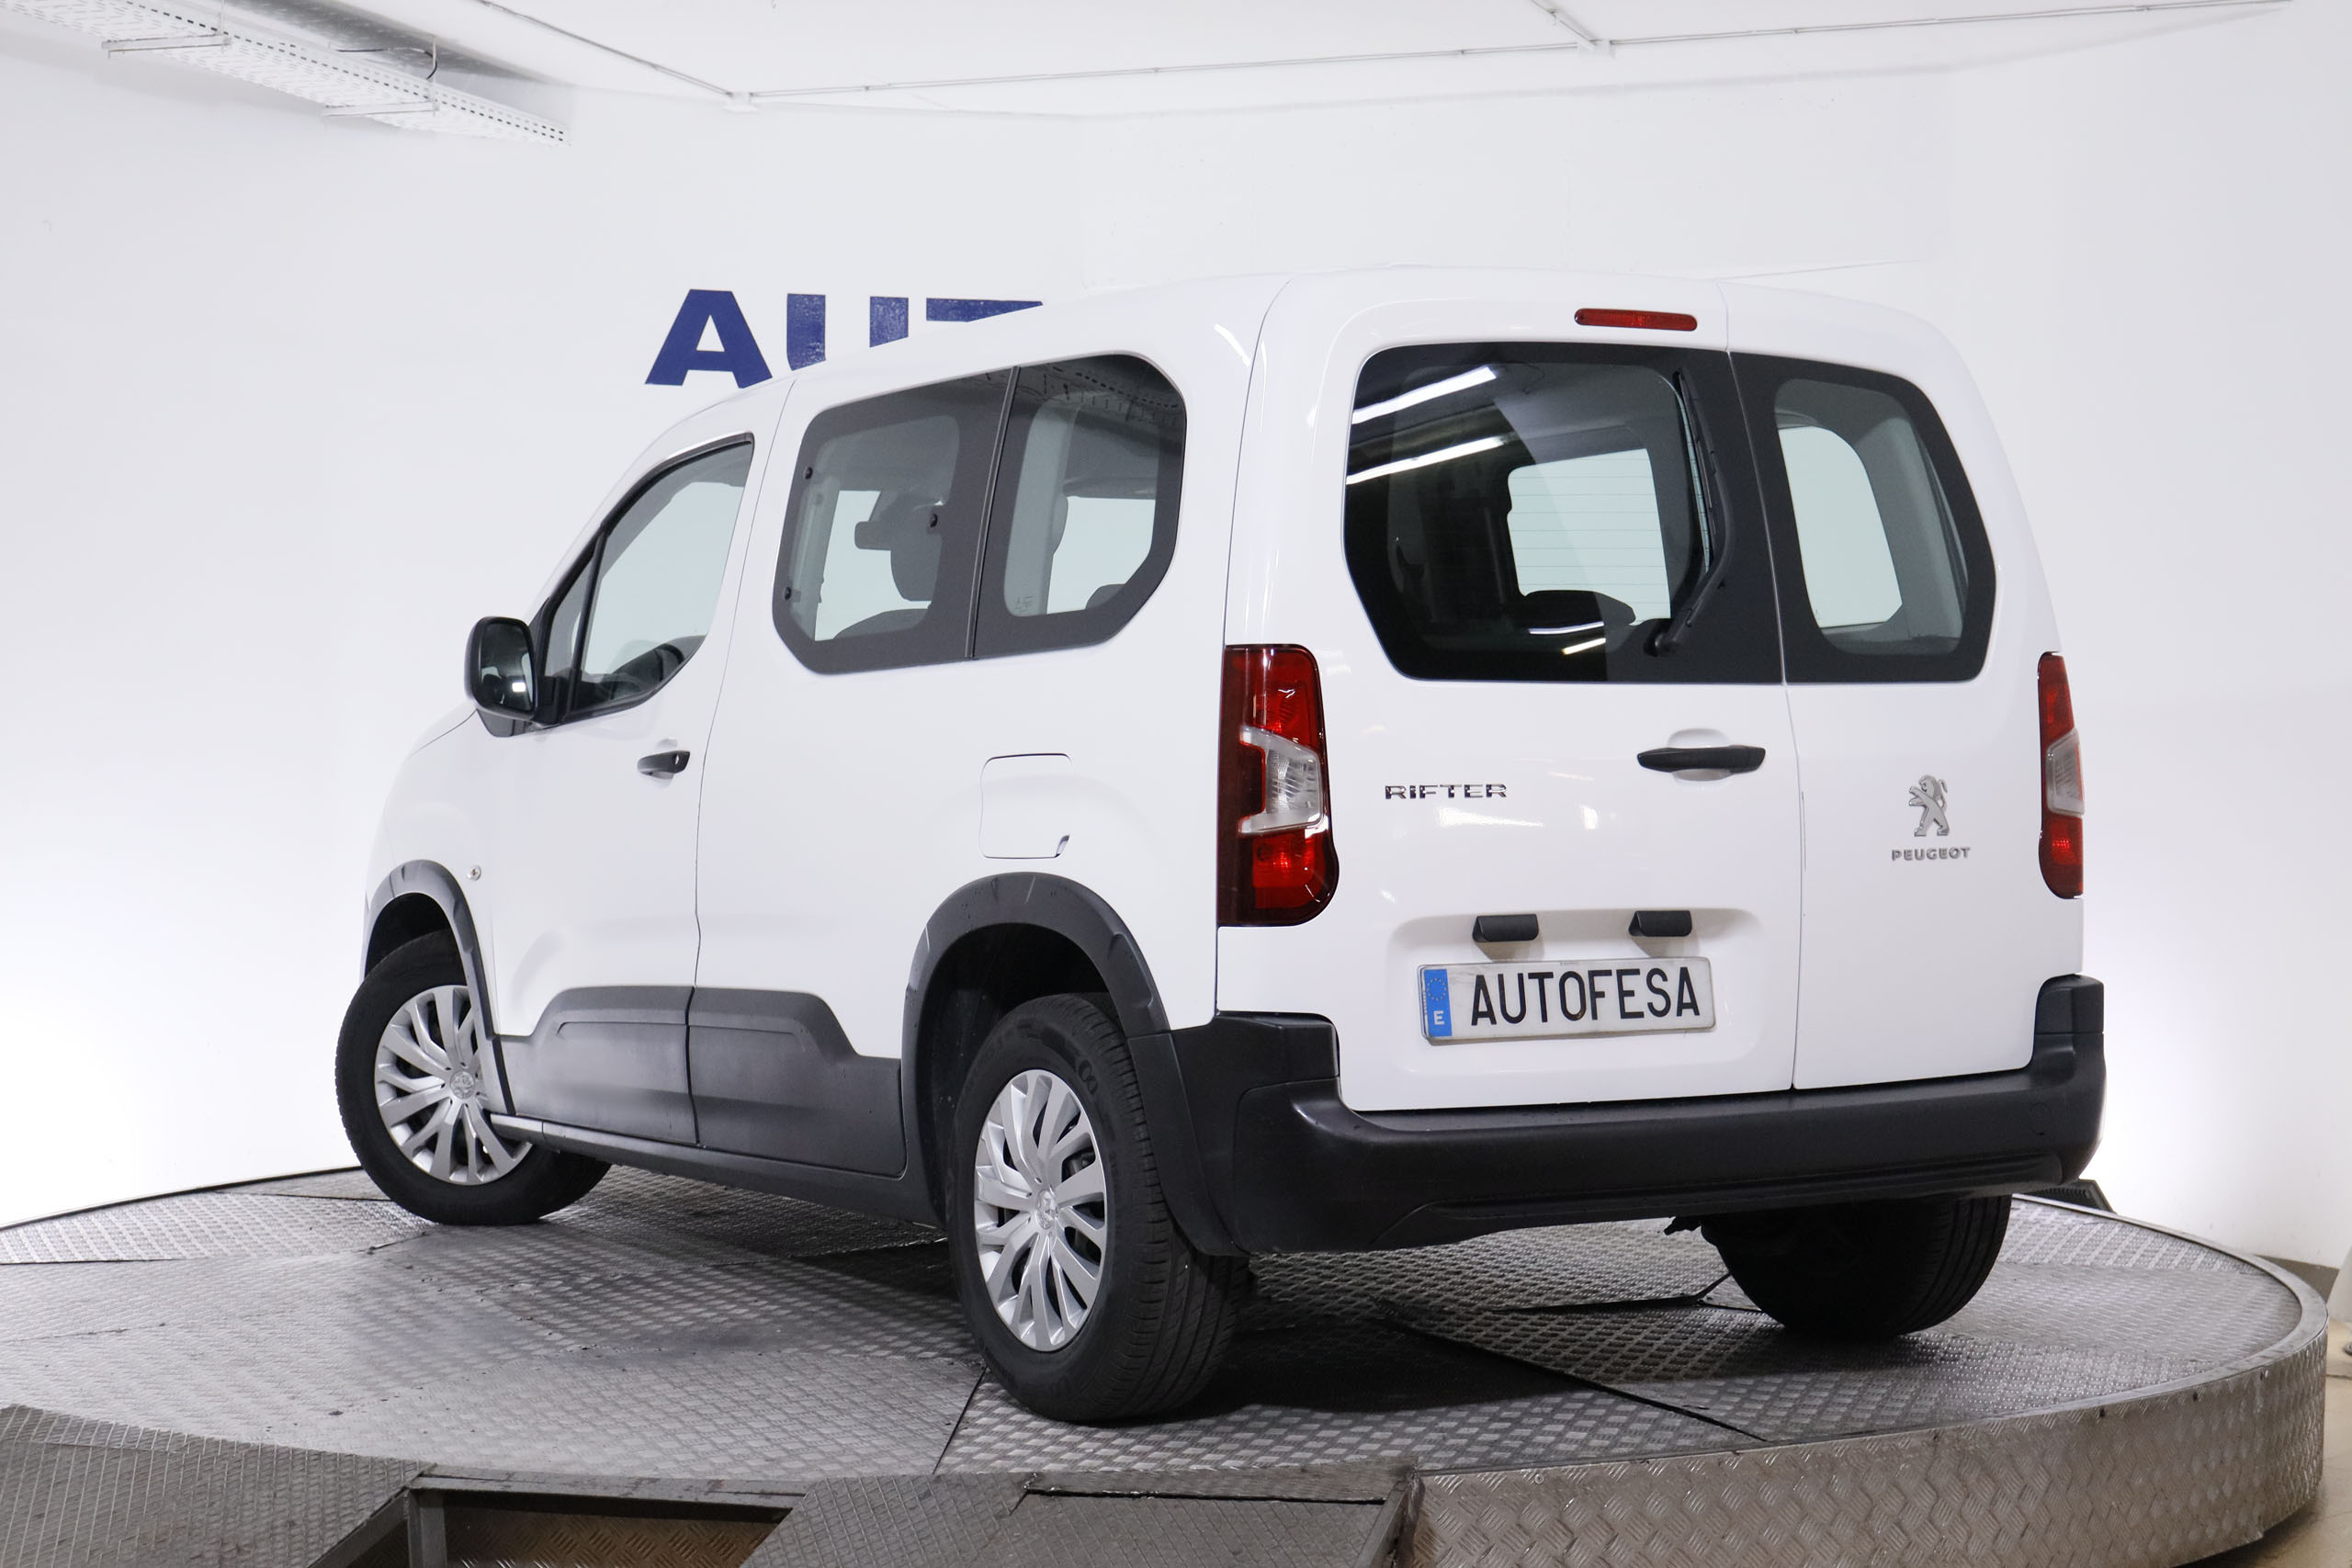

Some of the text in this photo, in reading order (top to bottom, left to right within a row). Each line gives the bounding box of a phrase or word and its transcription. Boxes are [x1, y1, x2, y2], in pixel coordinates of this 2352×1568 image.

[1385, 784, 1507, 800] RIFTER
[1891, 846, 1970, 862] PEUGEOT
[1471, 966, 1701, 1026] AUTOFESA
[1433, 1010, 1445, 1025] E
